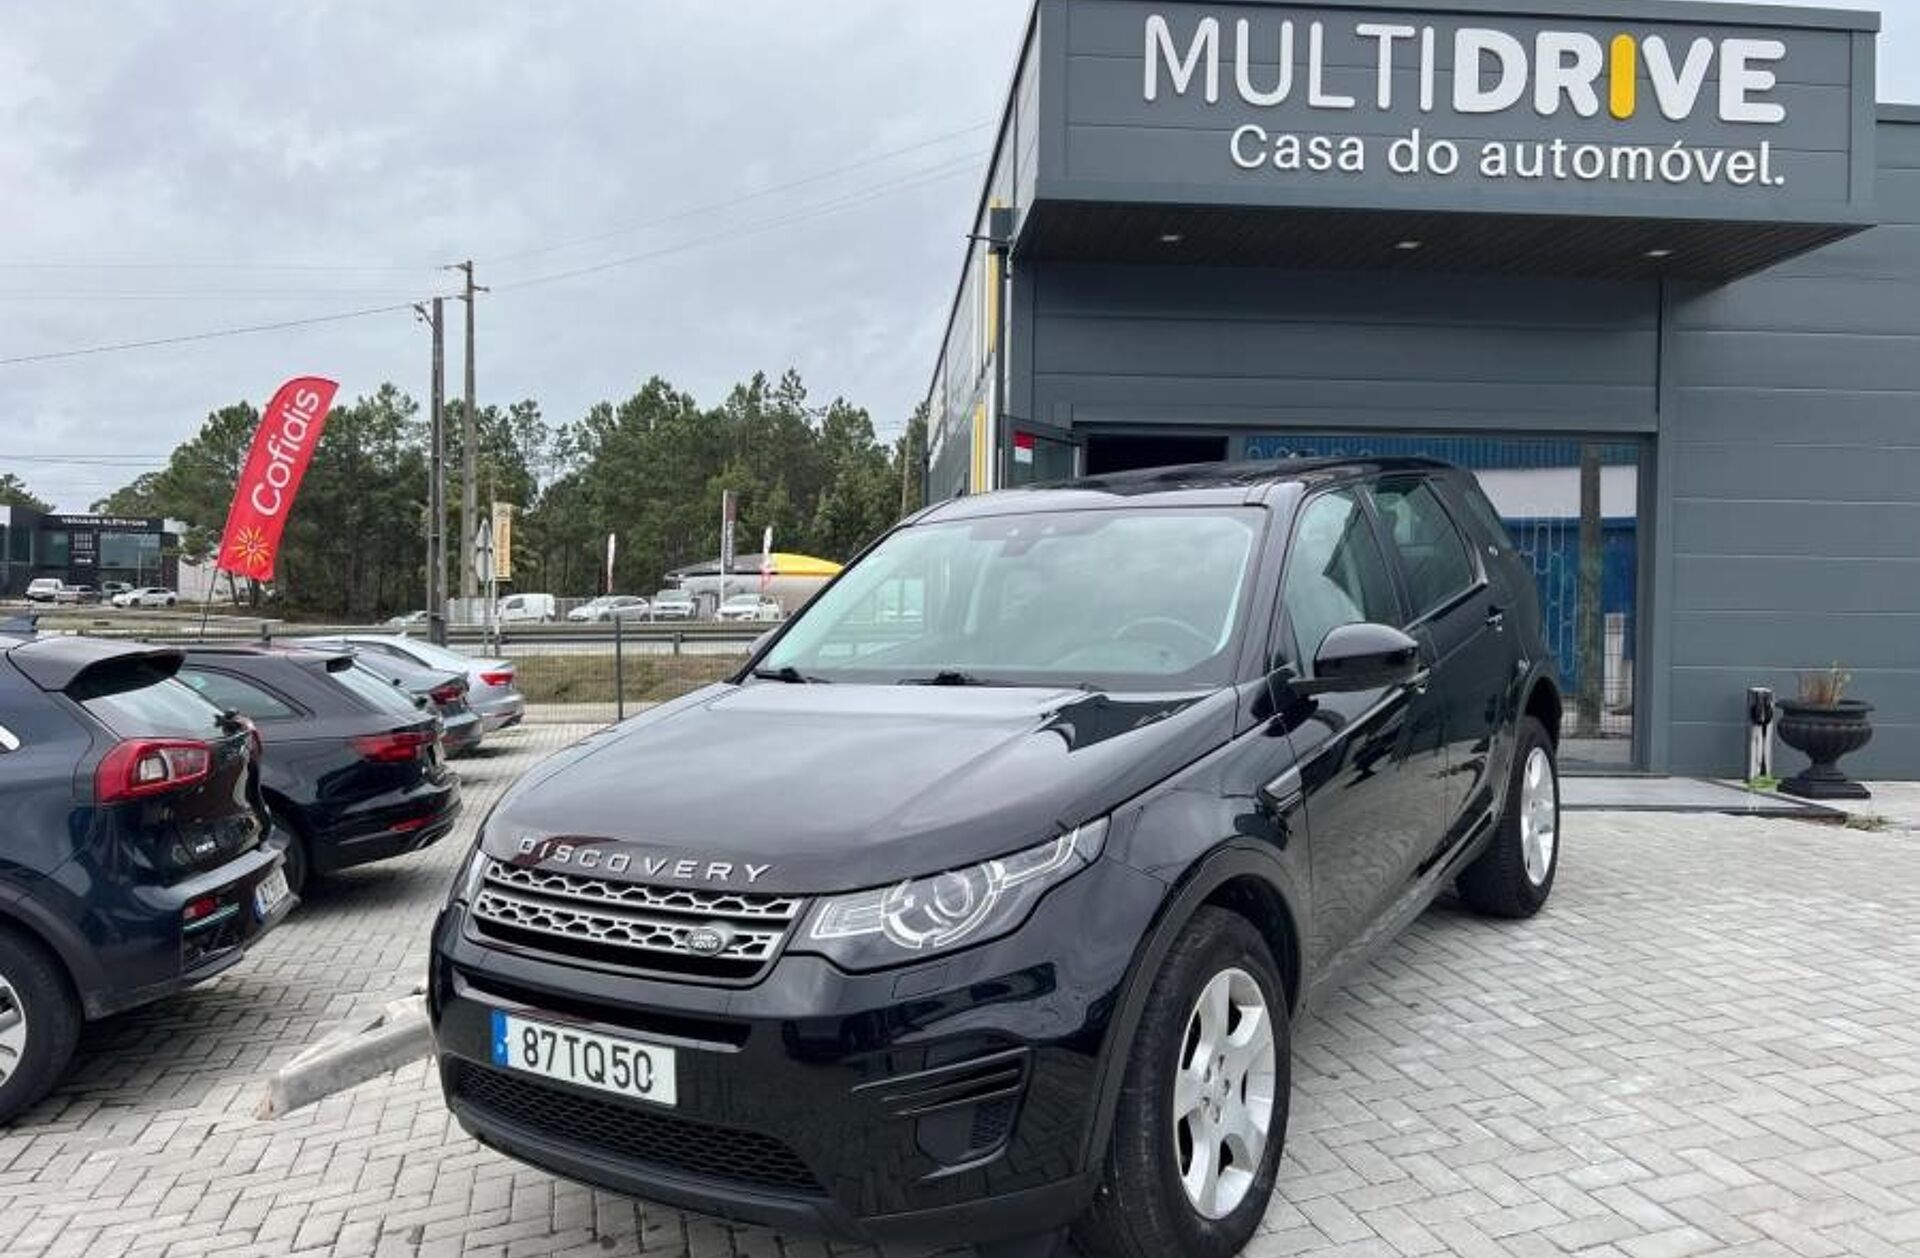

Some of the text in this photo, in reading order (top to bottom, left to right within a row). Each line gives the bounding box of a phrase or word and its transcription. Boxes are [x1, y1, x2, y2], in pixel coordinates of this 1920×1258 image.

[1142, 14, 1788, 124] MULTIDRIVE
[1229, 123, 1787, 188] Casa do automóvel.
[251, 388, 320, 517] Cofidis
[519, 838, 772, 883] DISCOVERY
[522, 1026, 654, 1094] 87TQ50
